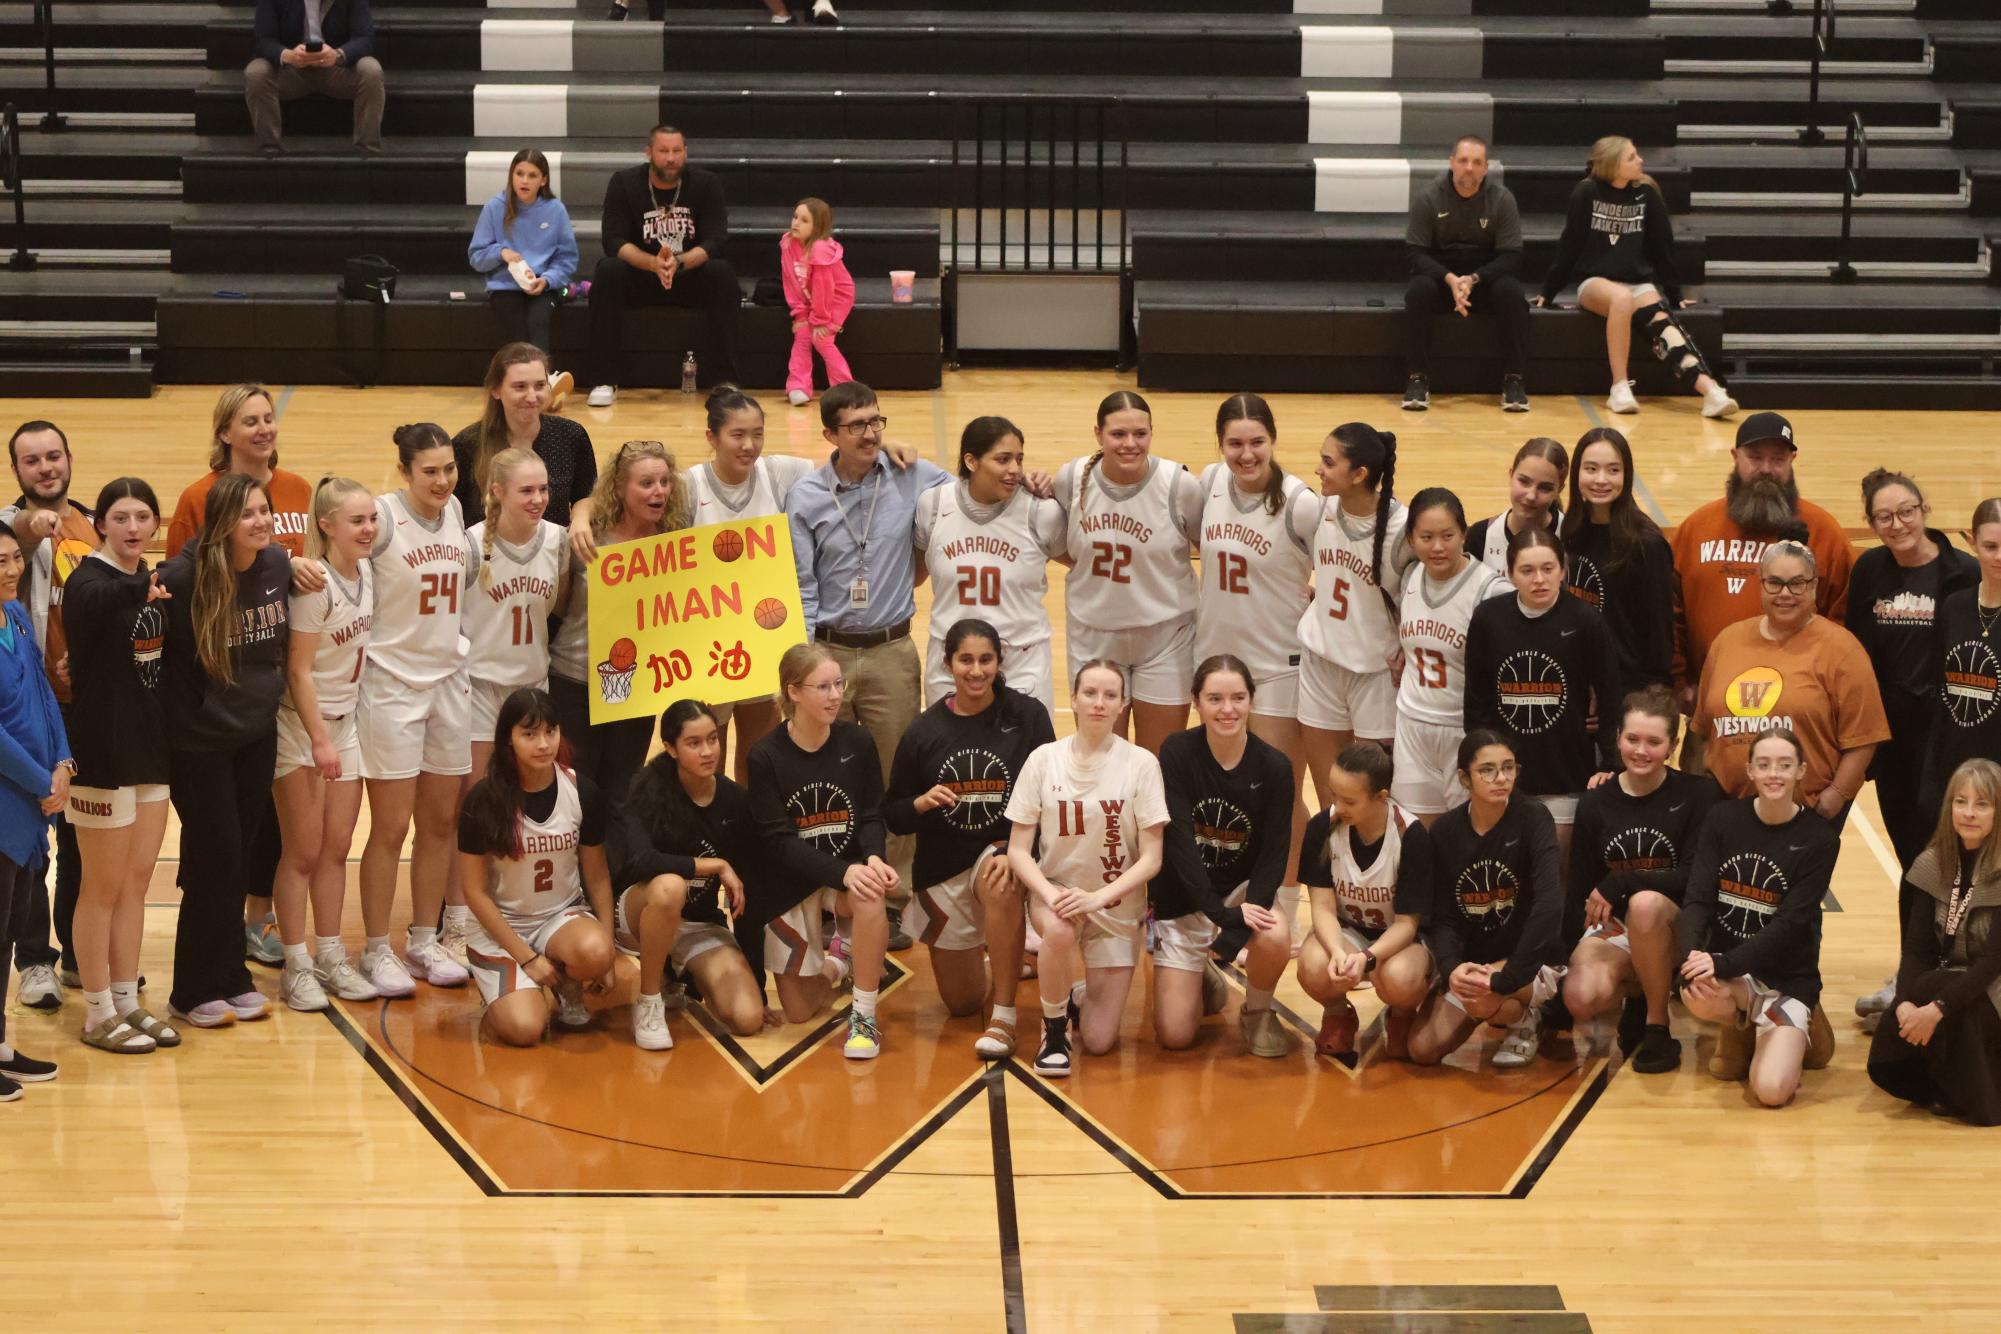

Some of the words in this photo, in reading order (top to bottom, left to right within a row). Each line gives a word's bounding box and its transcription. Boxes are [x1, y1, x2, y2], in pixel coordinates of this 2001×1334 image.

[643, 218, 696, 240] PLAYOFFS
[1080, 513, 1153, 544] WARRIORS
[1205, 523, 1272, 557] WARRIORS
[403, 545, 465, 569] WARRIORS
[601, 536, 698, 586] GAME
[943, 536, 1020, 563] WARRIORS
[1091, 541, 1132, 584] 22
[1700, 539, 1767, 563] WARRI
[1217, 551, 1249, 595] 12
[1319, 549, 1375, 586] WARRIORS
[419, 573, 458, 615] 24
[489, 575, 554, 603] WARRIORS
[956, 565, 1001, 606] 20
[1329, 577, 1350, 621] 5
[1726, 577, 1747, 594] W
[330, 614, 373, 647] WARRIO
[511, 604, 534, 646] 11
[1401, 619, 1466, 650] WARRIORS
[647, 640, 751, 693] 加油
[1415, 647, 1447, 689] 13
[1945, 672, 1998, 689] WARRIOR
[1500, 682, 1562, 693] WARRIOR
[1740, 680, 1773, 709] W
[526, 830, 578, 854] RRIORS
[1099, 799, 1126, 909] WESTWO
[534, 858, 554, 893] 2
